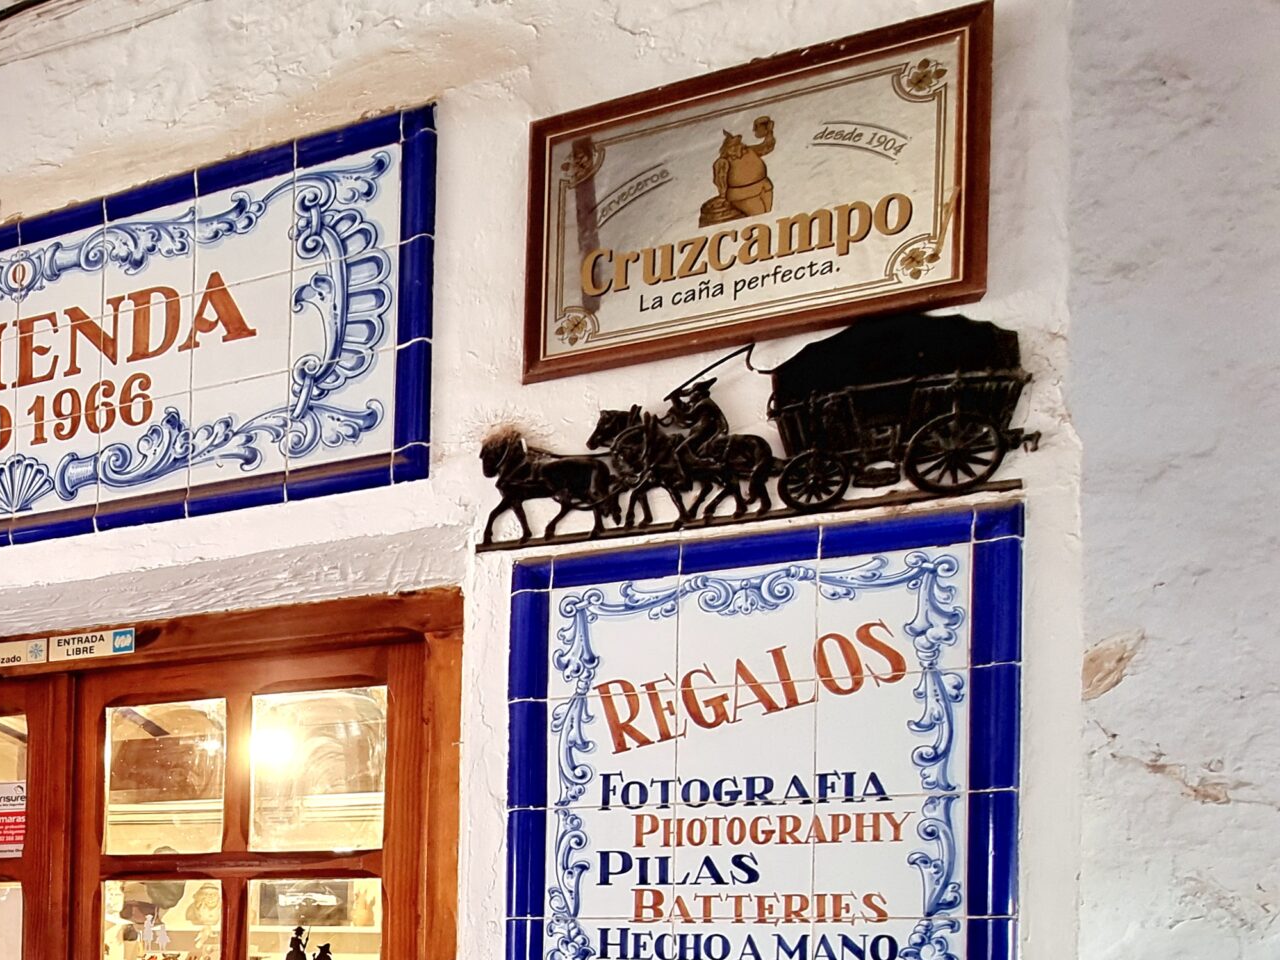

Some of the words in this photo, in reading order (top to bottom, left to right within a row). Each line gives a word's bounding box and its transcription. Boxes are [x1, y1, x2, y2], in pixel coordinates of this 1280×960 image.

[814, 124, 865, 146] desde
[866, 131, 907, 156] 1904
[581, 192, 915, 297] Cruzcampo
[639, 293, 663, 313] La
[671, 278, 725, 307] caña
[732, 258, 841, 301] perfecta.
[28, 371, 155, 447] 1966
[57, 634, 105, 647] ENTRADA
[66, 645, 95, 657] LIBRE
[593, 617, 908, 755] REGALOS
[597, 771, 893, 812] FOTOGRAFIA
[631, 810, 917, 849] PHOTOGRAPHY
[596, 851, 761, 887] PILAS
[628, 888, 889, 927] BATTERIES
